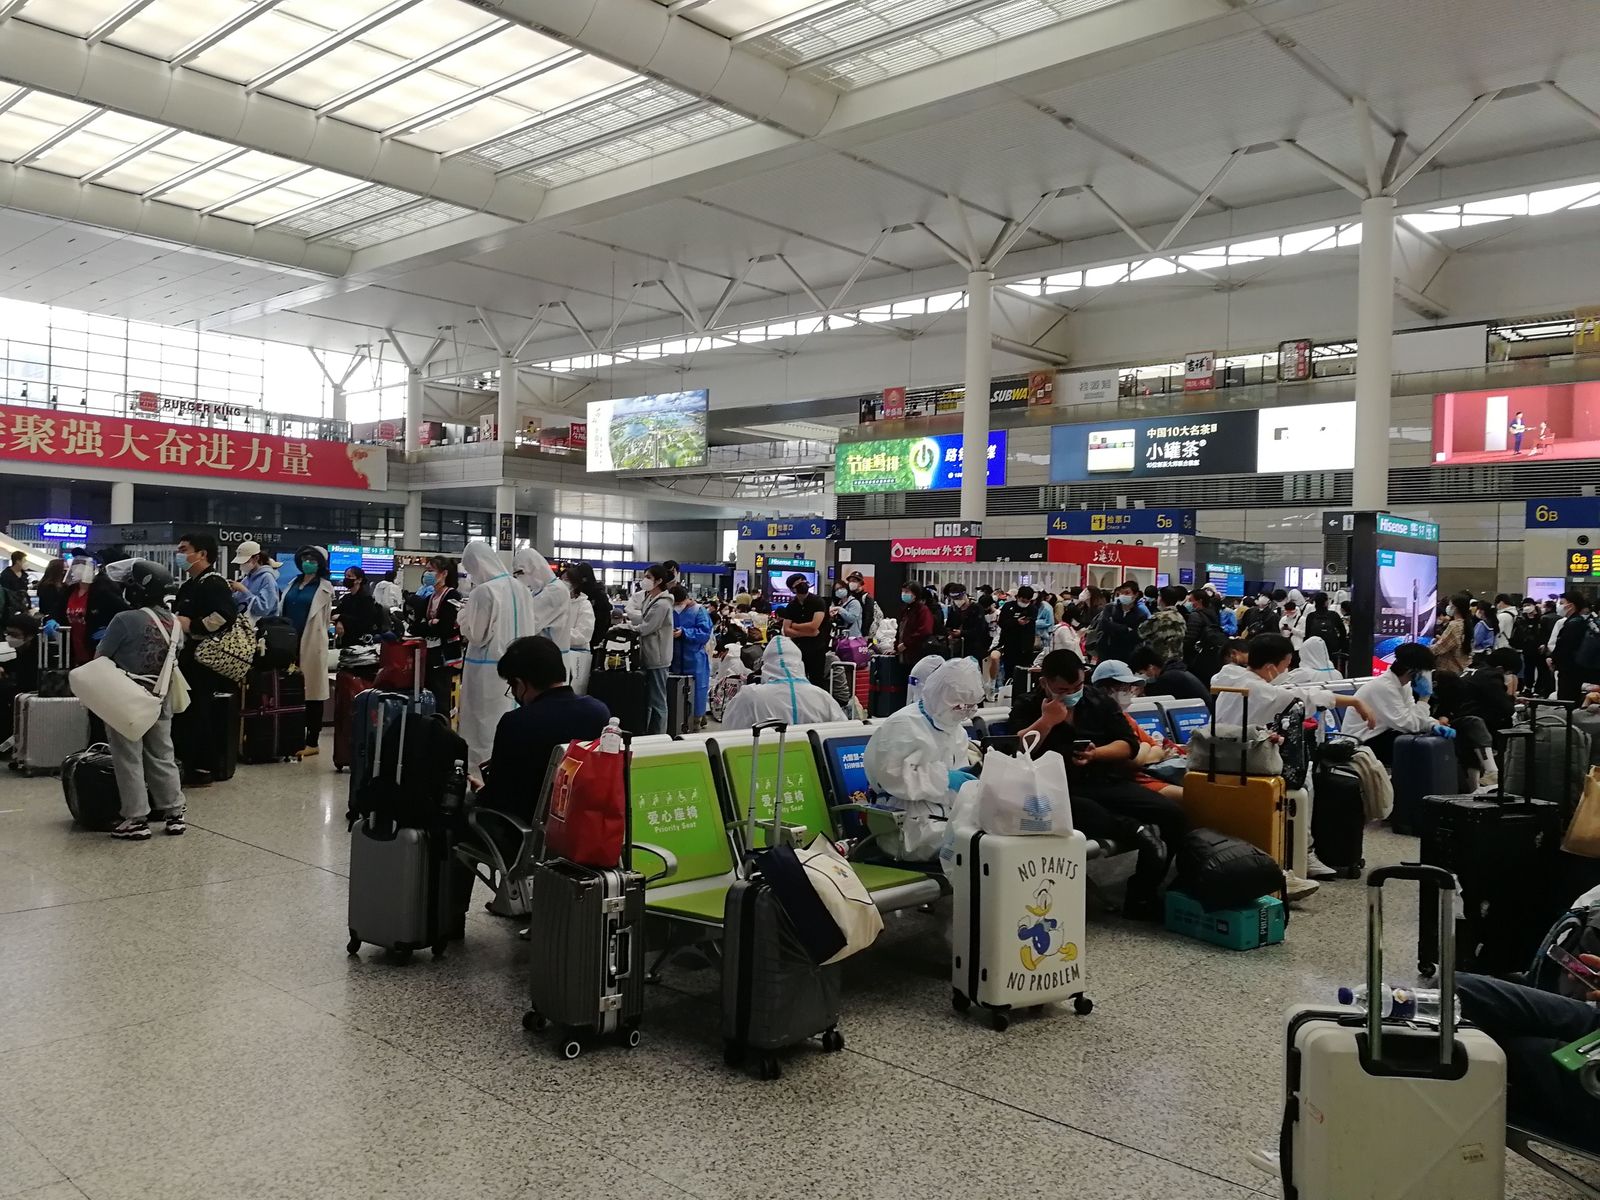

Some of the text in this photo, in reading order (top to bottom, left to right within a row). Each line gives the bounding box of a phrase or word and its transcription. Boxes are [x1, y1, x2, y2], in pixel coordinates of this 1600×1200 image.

[163, 399, 241, 416] BURGER KING
[0, 411, 314, 476] 聚强大奋进力量
[1535, 504, 1558, 522] 6B
[1052, 517, 1067, 530] 4B
[1156, 514, 1173, 528] 5B
[1380, 517, 1408, 534] Hisense
[501, 529, 512, 540] 1B
[810, 524, 821, 535] 3B
[331, 545, 360, 553] Hisense
[904, 546, 941, 557] Diplomat
[941, 545, 974, 556] 外交官
[1571, 553, 1588, 563] 6B
[761, 790, 805, 807] 爱座椅
[647, 805, 699, 825] 爱心座椅
[655, 822, 697, 833] Priority Seat
[1017, 856, 1079, 882] NO PANTS
[1006, 963, 1081, 991] NO PROBLEM
